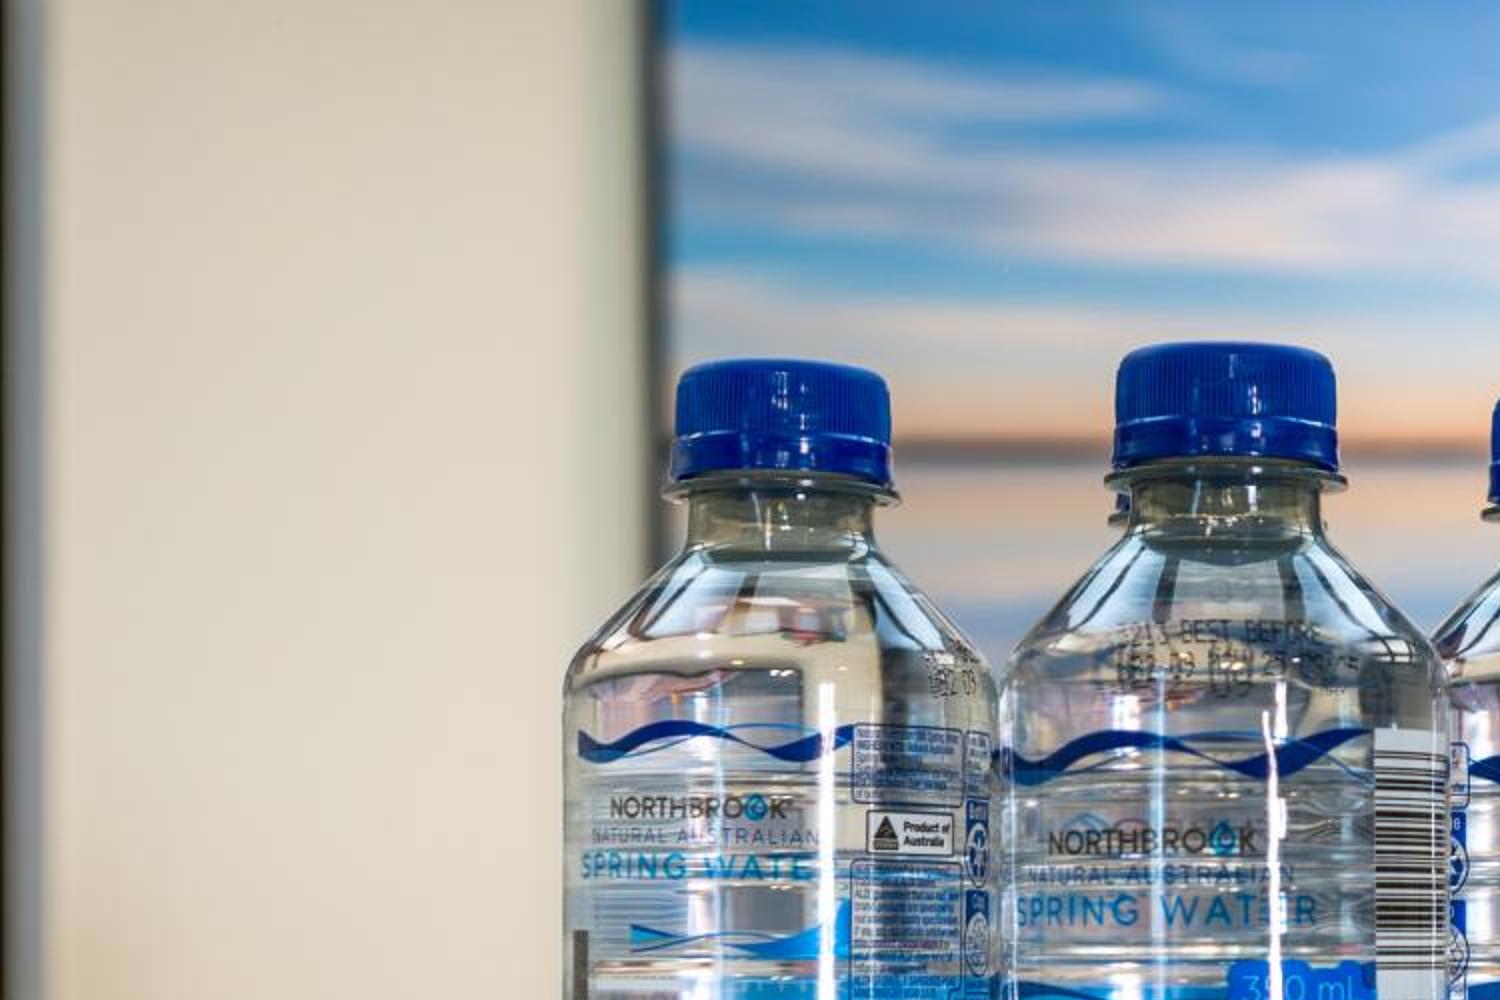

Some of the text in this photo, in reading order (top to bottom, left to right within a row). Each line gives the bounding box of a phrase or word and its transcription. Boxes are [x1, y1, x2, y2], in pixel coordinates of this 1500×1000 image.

[610, 793, 788, 821] NORTHBROOK
[903, 821, 940, 833] Product
[903, 836, 945, 847] Australia
[1048, 821, 1258, 857] NORTHBROOK
[581, 850, 686, 880] SPRING
[703, 850, 819, 880] WATE
[1017, 892, 1140, 927] SPRING
[1160, 894, 1317, 928] WATR
